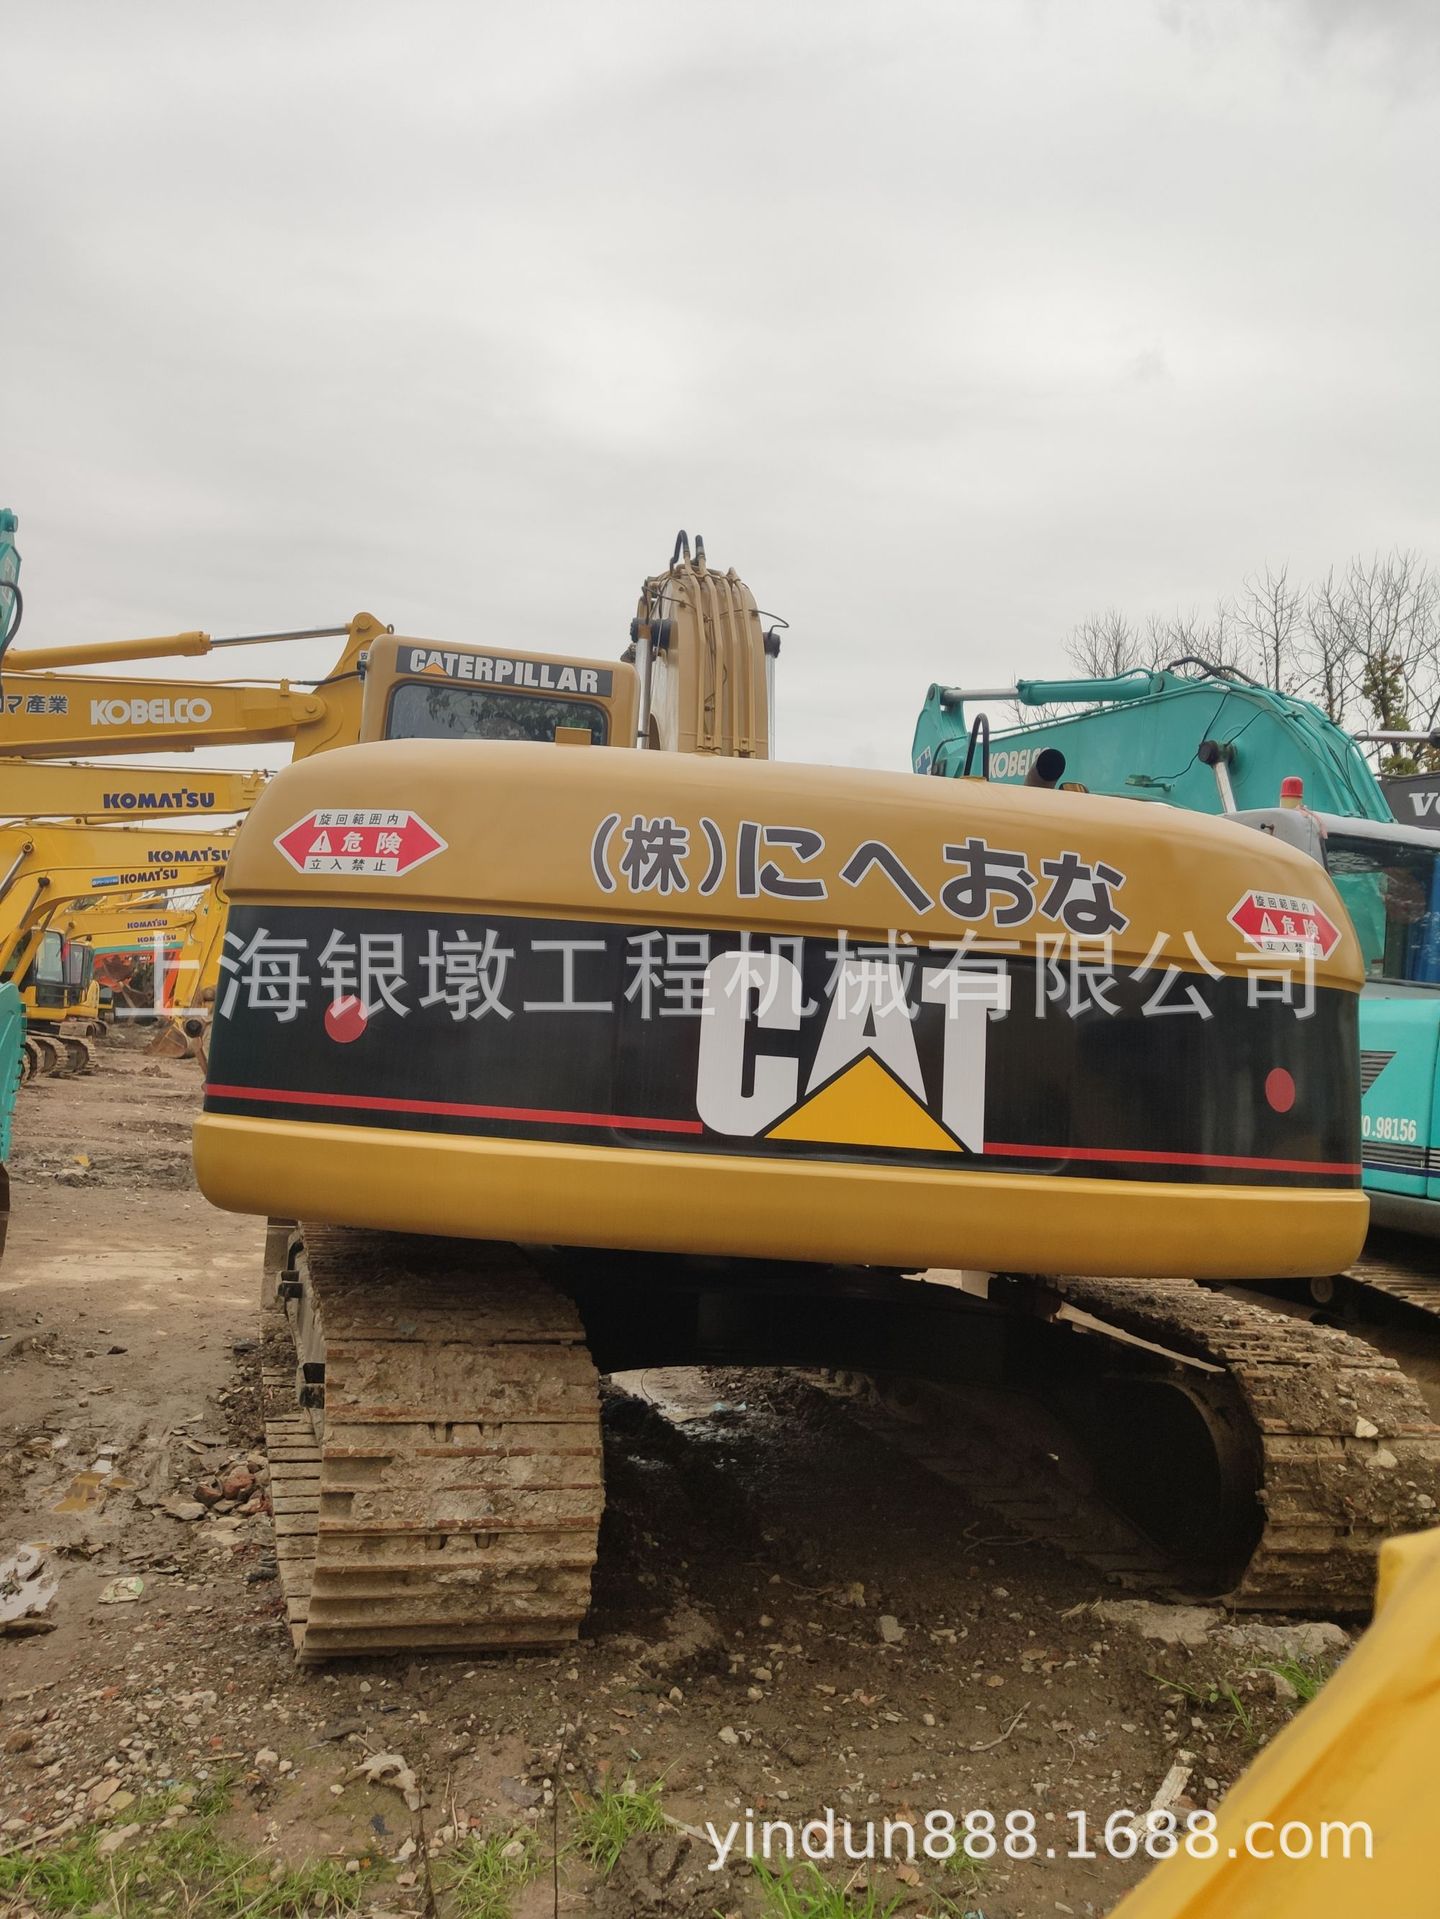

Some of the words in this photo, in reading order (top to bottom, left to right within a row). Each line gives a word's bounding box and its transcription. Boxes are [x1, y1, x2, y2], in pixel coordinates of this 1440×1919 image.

[409, 648, 599, 694] CATERPILLAR
[0, 694, 69, 716] マ産業
[90, 698, 212, 725] KOBELCO
[989, 747, 1050, 779] KOBEL
[103, 788, 215, 809] KOMATSU
[1408, 792, 1440, 817] V
[318, 813, 399, 826] 旋回範囲内
[340, 831, 402, 855] 危険
[148, 847, 231, 862] KOMATSU
[309, 859, 387, 872] 立入禁止
[120, 867, 178, 884] KOMATSU
[127, 919, 168, 929] KOMATSU
[696, 950, 1012, 1154] CAT
